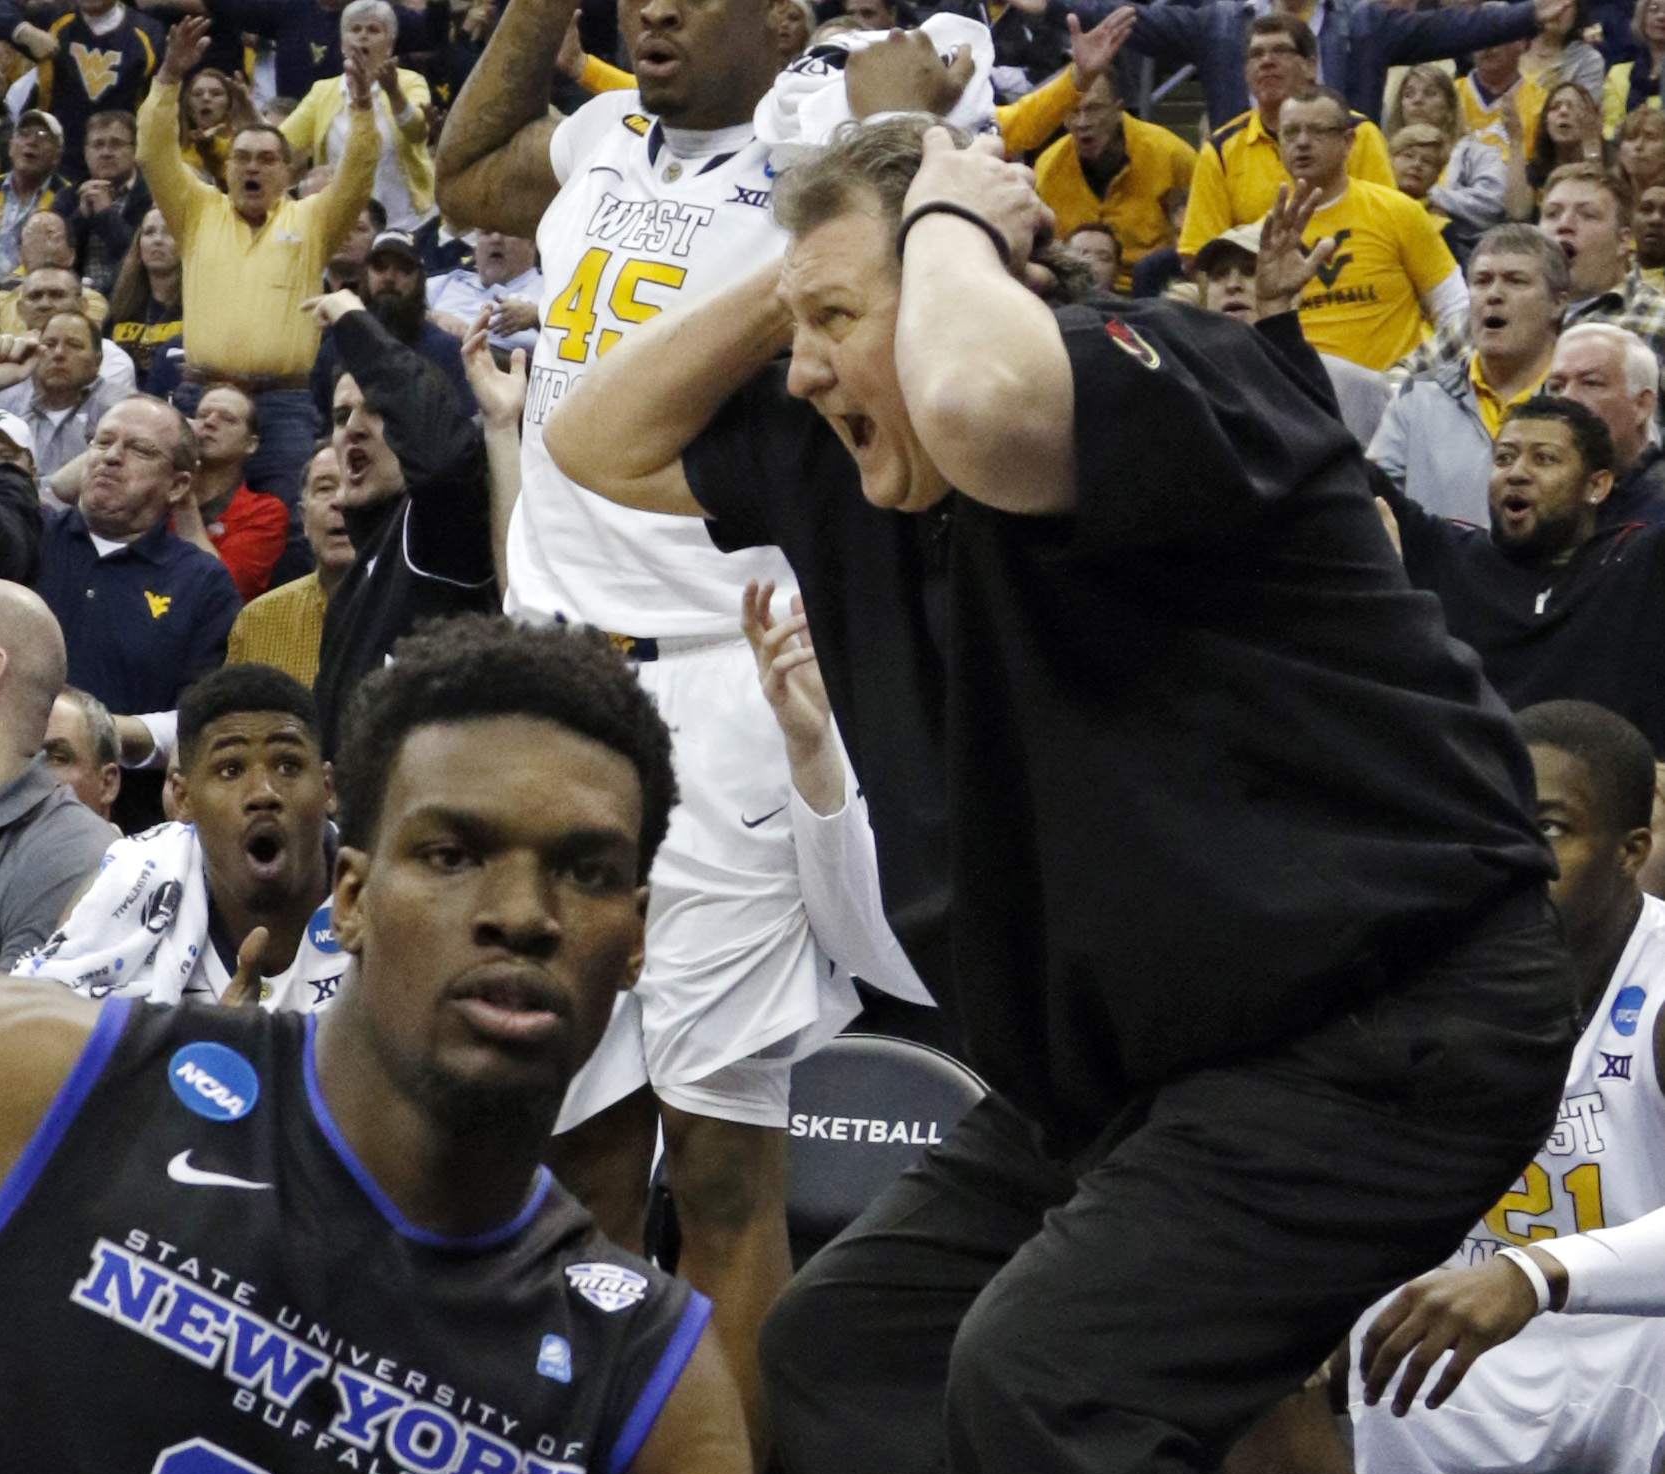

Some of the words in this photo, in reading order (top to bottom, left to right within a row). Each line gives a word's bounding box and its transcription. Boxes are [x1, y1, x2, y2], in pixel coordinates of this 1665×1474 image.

[586, 191, 715, 258] WEST
[545, 246, 688, 365] 45
[176, 1061, 245, 1117] NCAA
[1541, 1091, 1606, 1157] ST
[1482, 1161, 1606, 1248] 21
[70, 1237, 331, 1410] NEW
[570, 1276, 645, 1300] MAC
[123, 1229, 258, 1307] STATE
[277, 1306, 520, 1437] UNIVERSITY
[538, 1436, 584, 1460] OF
